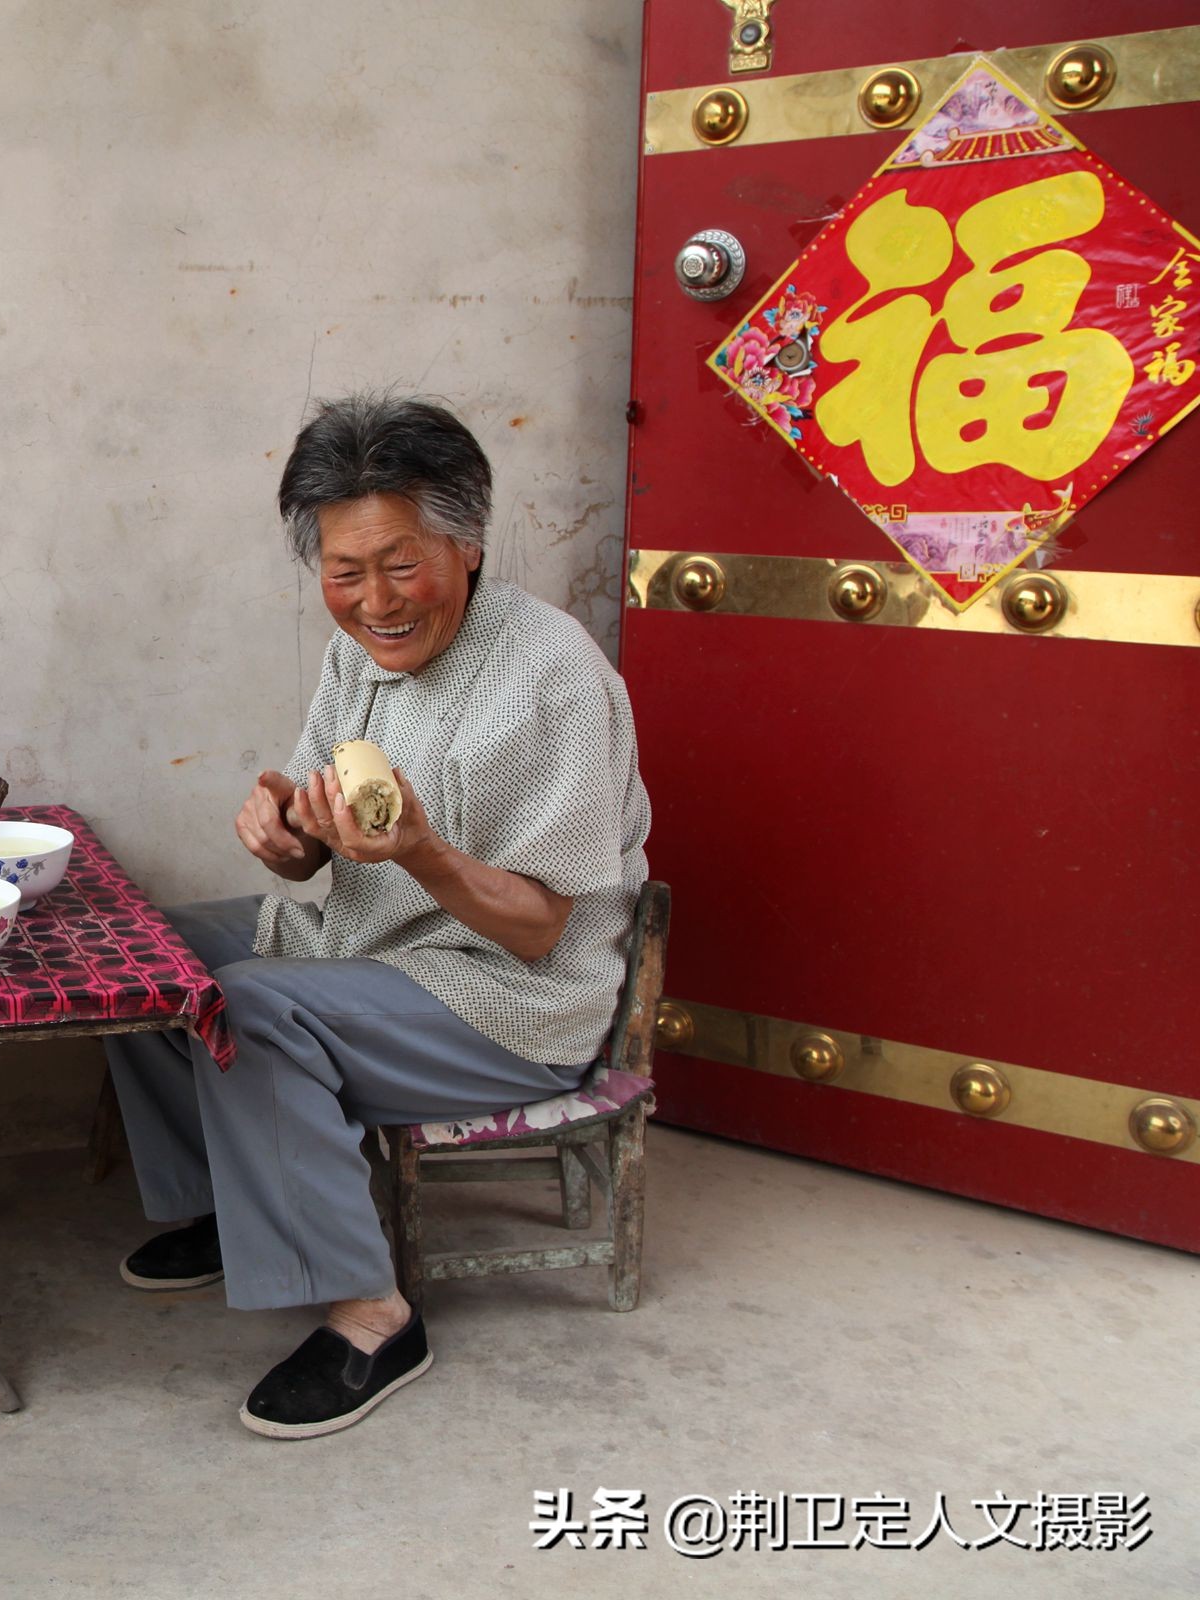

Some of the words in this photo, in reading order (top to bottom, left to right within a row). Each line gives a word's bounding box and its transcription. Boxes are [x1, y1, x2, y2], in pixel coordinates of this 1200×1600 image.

[815, 170, 1135, 487] 福
[1143, 247, 1200, 386] 全家福
